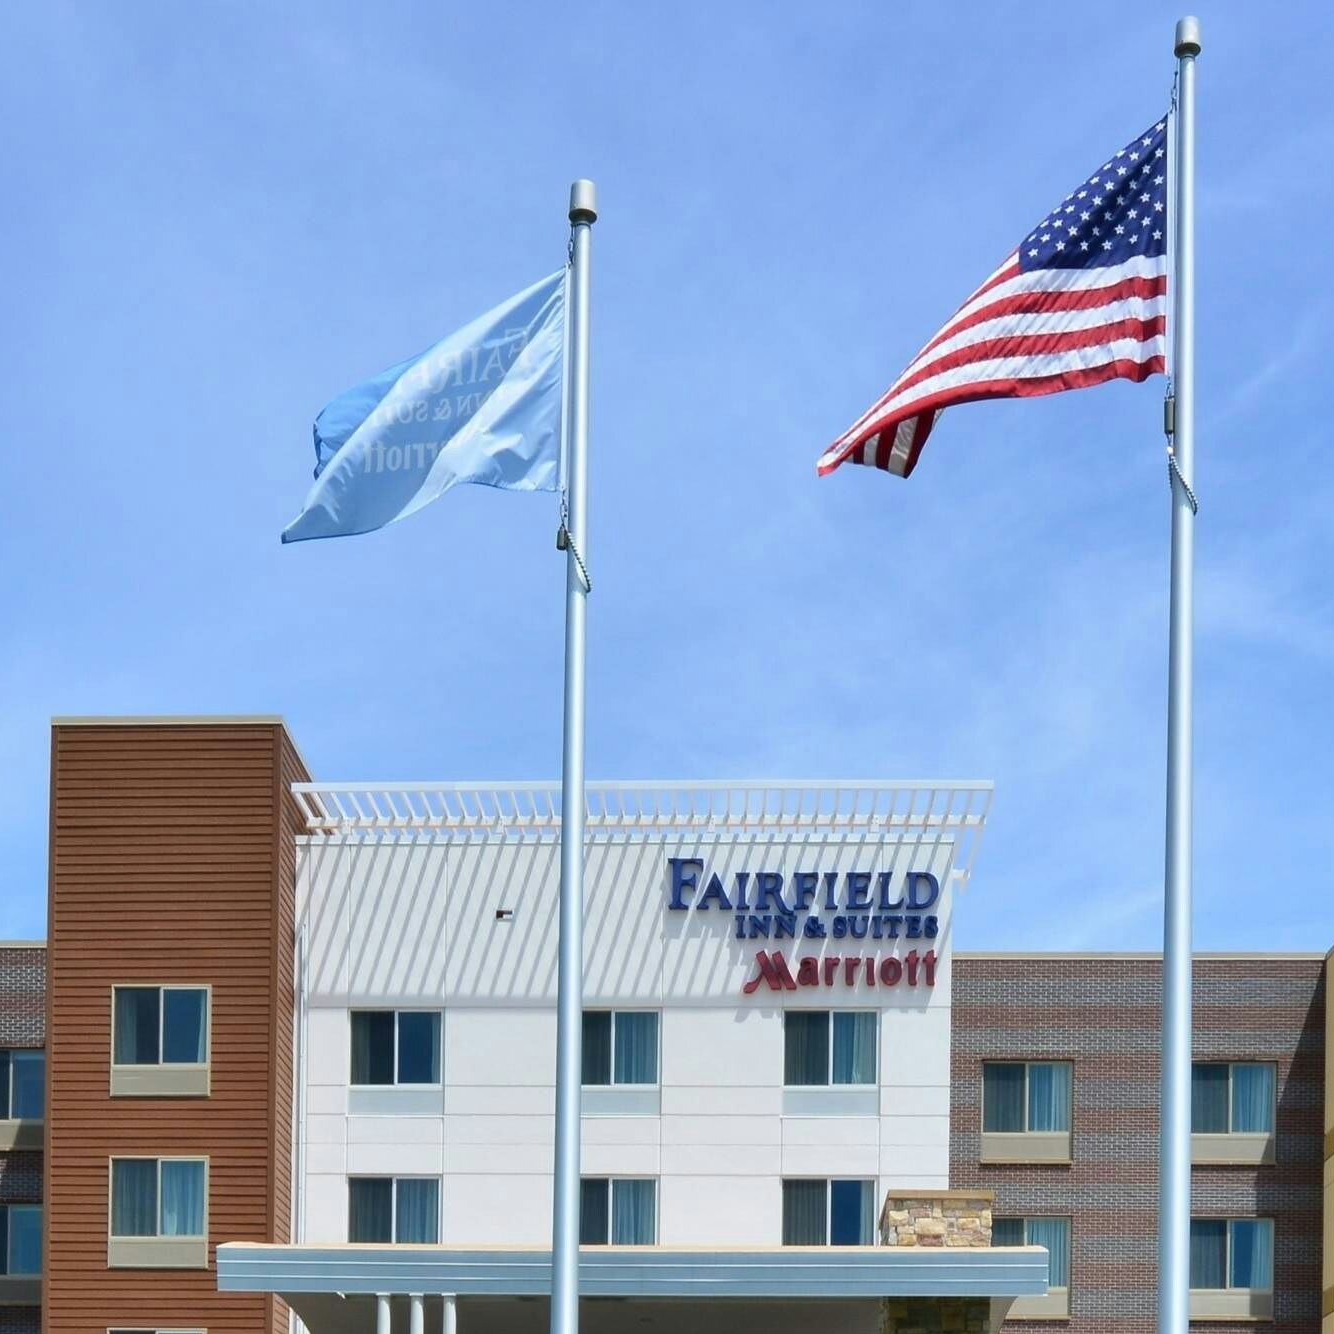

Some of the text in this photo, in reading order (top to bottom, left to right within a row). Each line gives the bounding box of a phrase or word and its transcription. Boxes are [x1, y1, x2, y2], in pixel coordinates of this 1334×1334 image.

[667, 857, 940, 916] FAIRFIELD
[735, 915, 940, 939] INN & SUITES
[742, 949, 939, 994] Marriott
